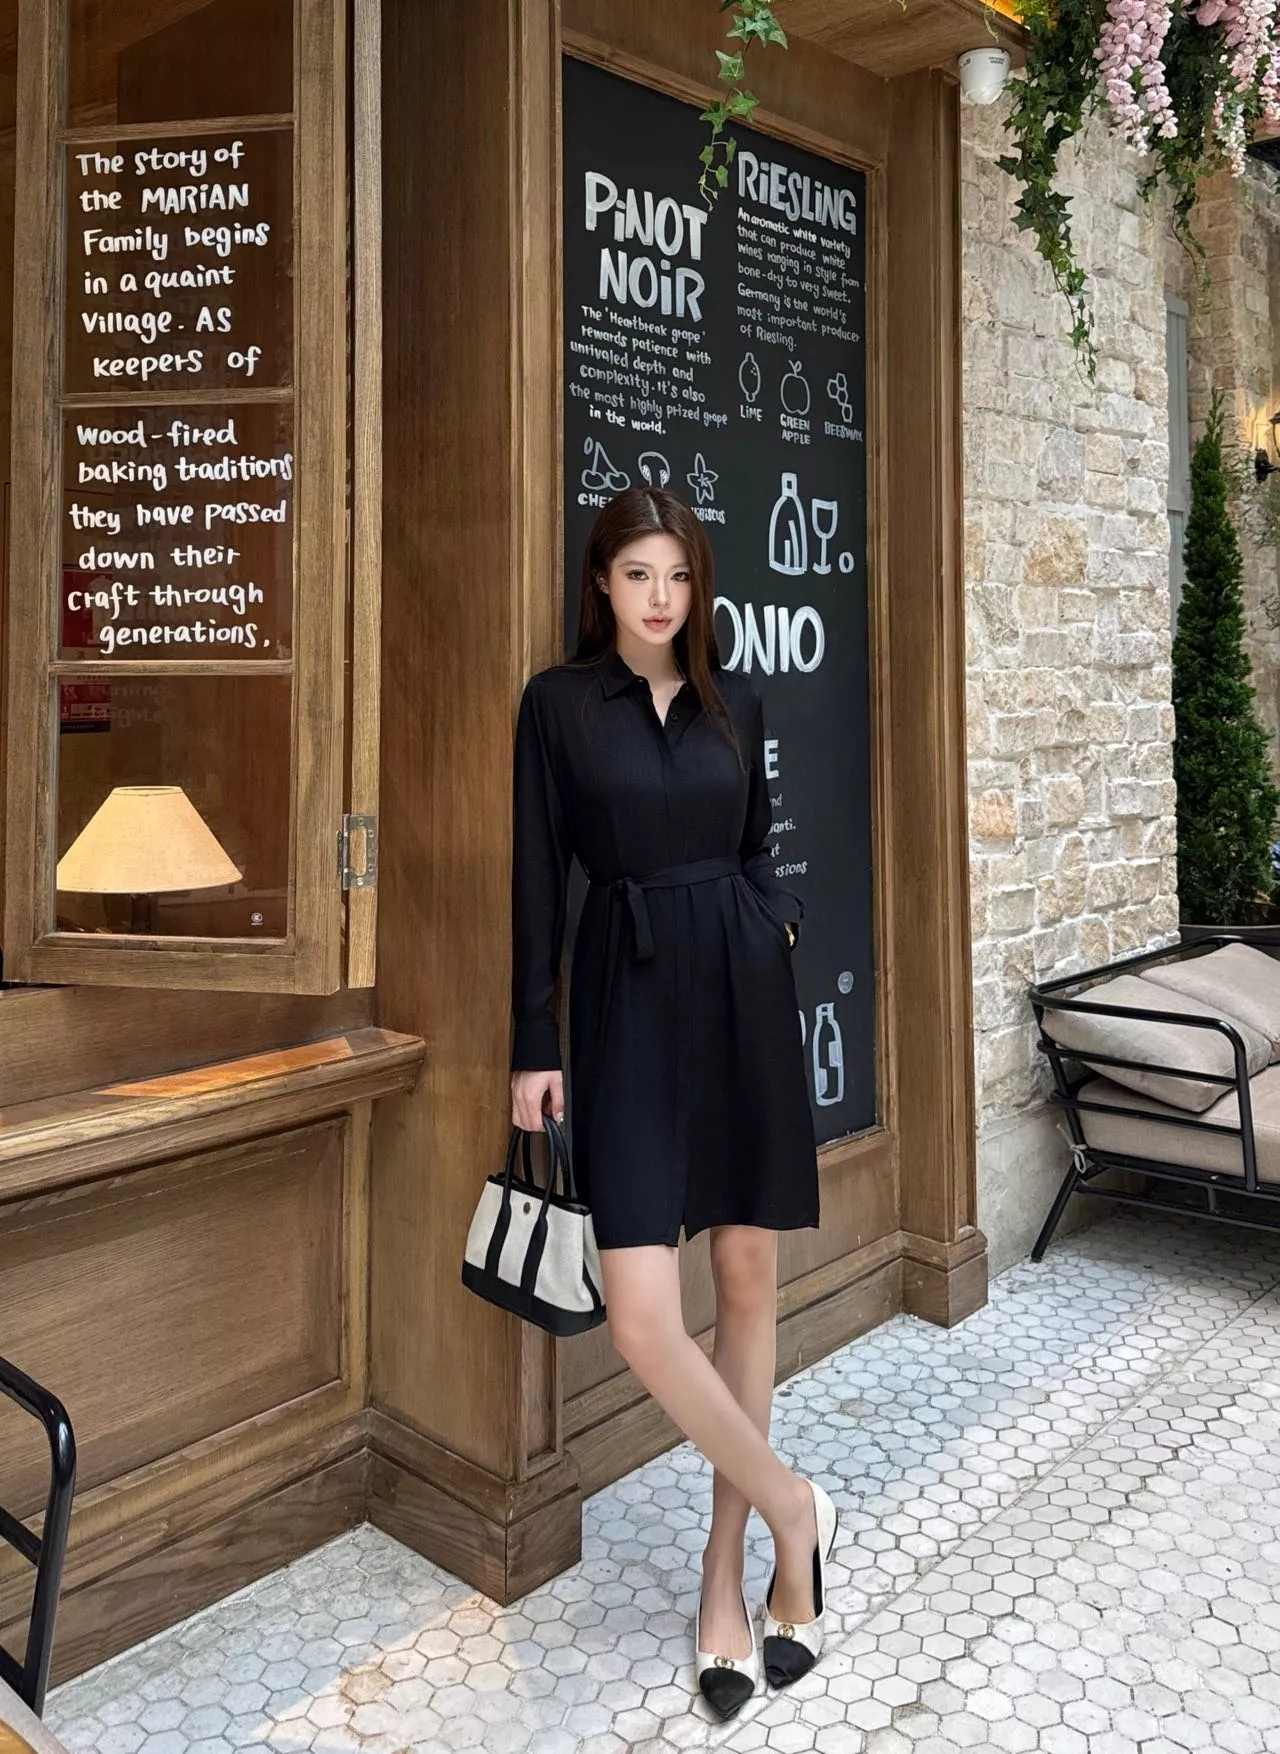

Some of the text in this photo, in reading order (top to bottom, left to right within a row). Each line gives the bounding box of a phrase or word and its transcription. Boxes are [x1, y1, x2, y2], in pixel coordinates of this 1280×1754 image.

[76, 141, 245, 177] The story of
[80, 189, 122, 212] the
[84, 222, 270, 260] Family begins
[736, 224, 846, 270] that can produce white
[738, 206, 851, 259] An aromatic white variety
[84, 264, 236, 298] in a quaint
[738, 242, 762, 260] wines
[768, 252, 800, 274] ranging
[804, 261, 812, 275] in
[840, 273, 860, 288] from
[738, 262, 784, 290] bone-dry
[786, 276, 798, 288] to
[800, 280, 820, 299] very
[738, 282, 846, 324] Germany is the world's
[582, 305, 706, 346] The 'Heartbreak grape'
[736, 304, 860, 343] most important producer
[740, 324, 797, 352] of Riesling.
[228, 346, 262, 376] of
[570, 340, 694, 382] unrivaled depth and
[582, 325, 712, 365] rewards patience with
[569, 382, 728, 428] the most highly prized grape
[682, 386, 706, 402] also
[590, 405, 666, 436] in the world.
[780, 414, 810, 430] GREEN
[782, 430, 810, 444] APPLE
[824, 422, 863, 442] BEESWAX
[79, 462, 166, 491] baking
[174, 454, 293, 482] traditions
[578, 493, 614, 508] CHE
[69, 504, 120, 534] they
[136, 504, 194, 526] have
[79, 545, 240, 570] down their
[68, 582, 264, 620] craft through
[714, 596, 825, 676] ONIO
[775, 861, 808, 878] ssions
